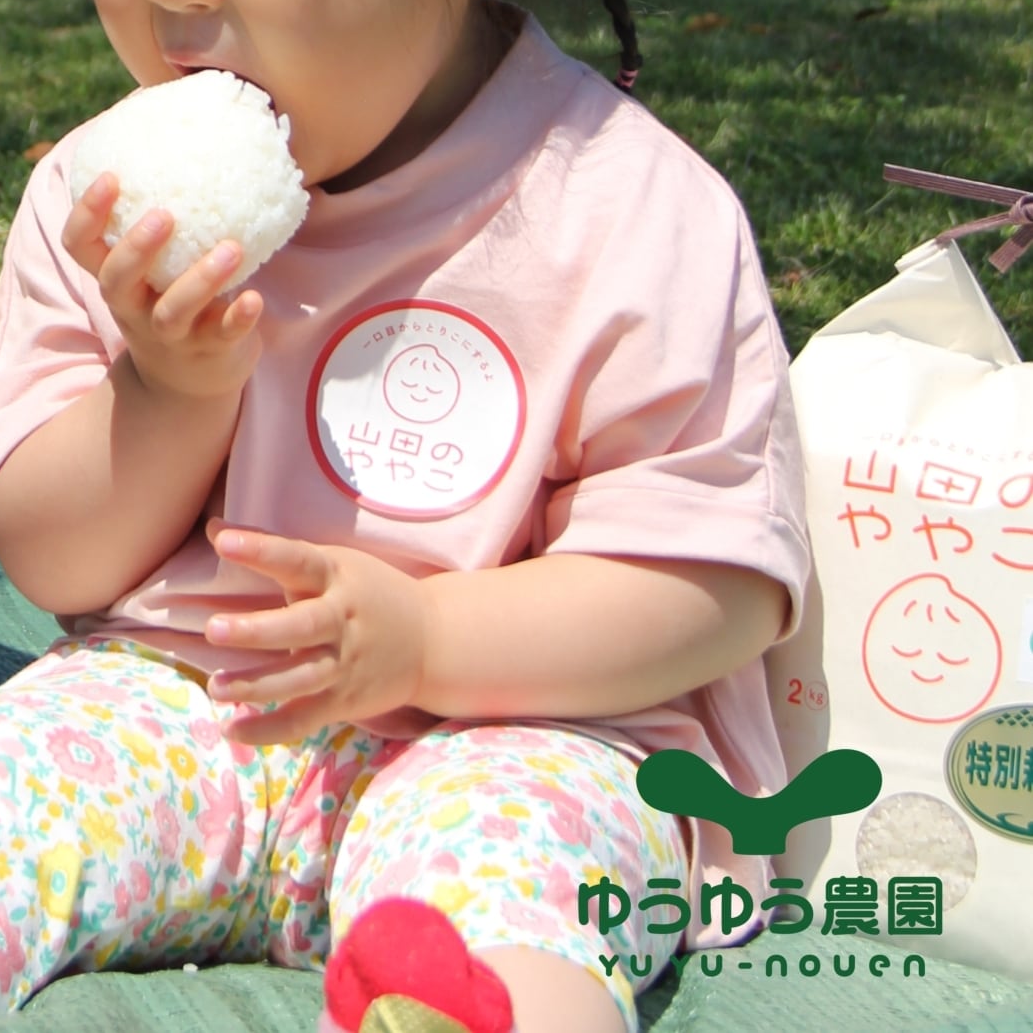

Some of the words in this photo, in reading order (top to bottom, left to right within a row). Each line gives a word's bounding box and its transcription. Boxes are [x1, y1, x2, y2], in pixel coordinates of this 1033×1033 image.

[348, 421, 464, 466] 山田の
[342, 446, 455, 493] ややこ
[787, 677, 803, 705] 2
